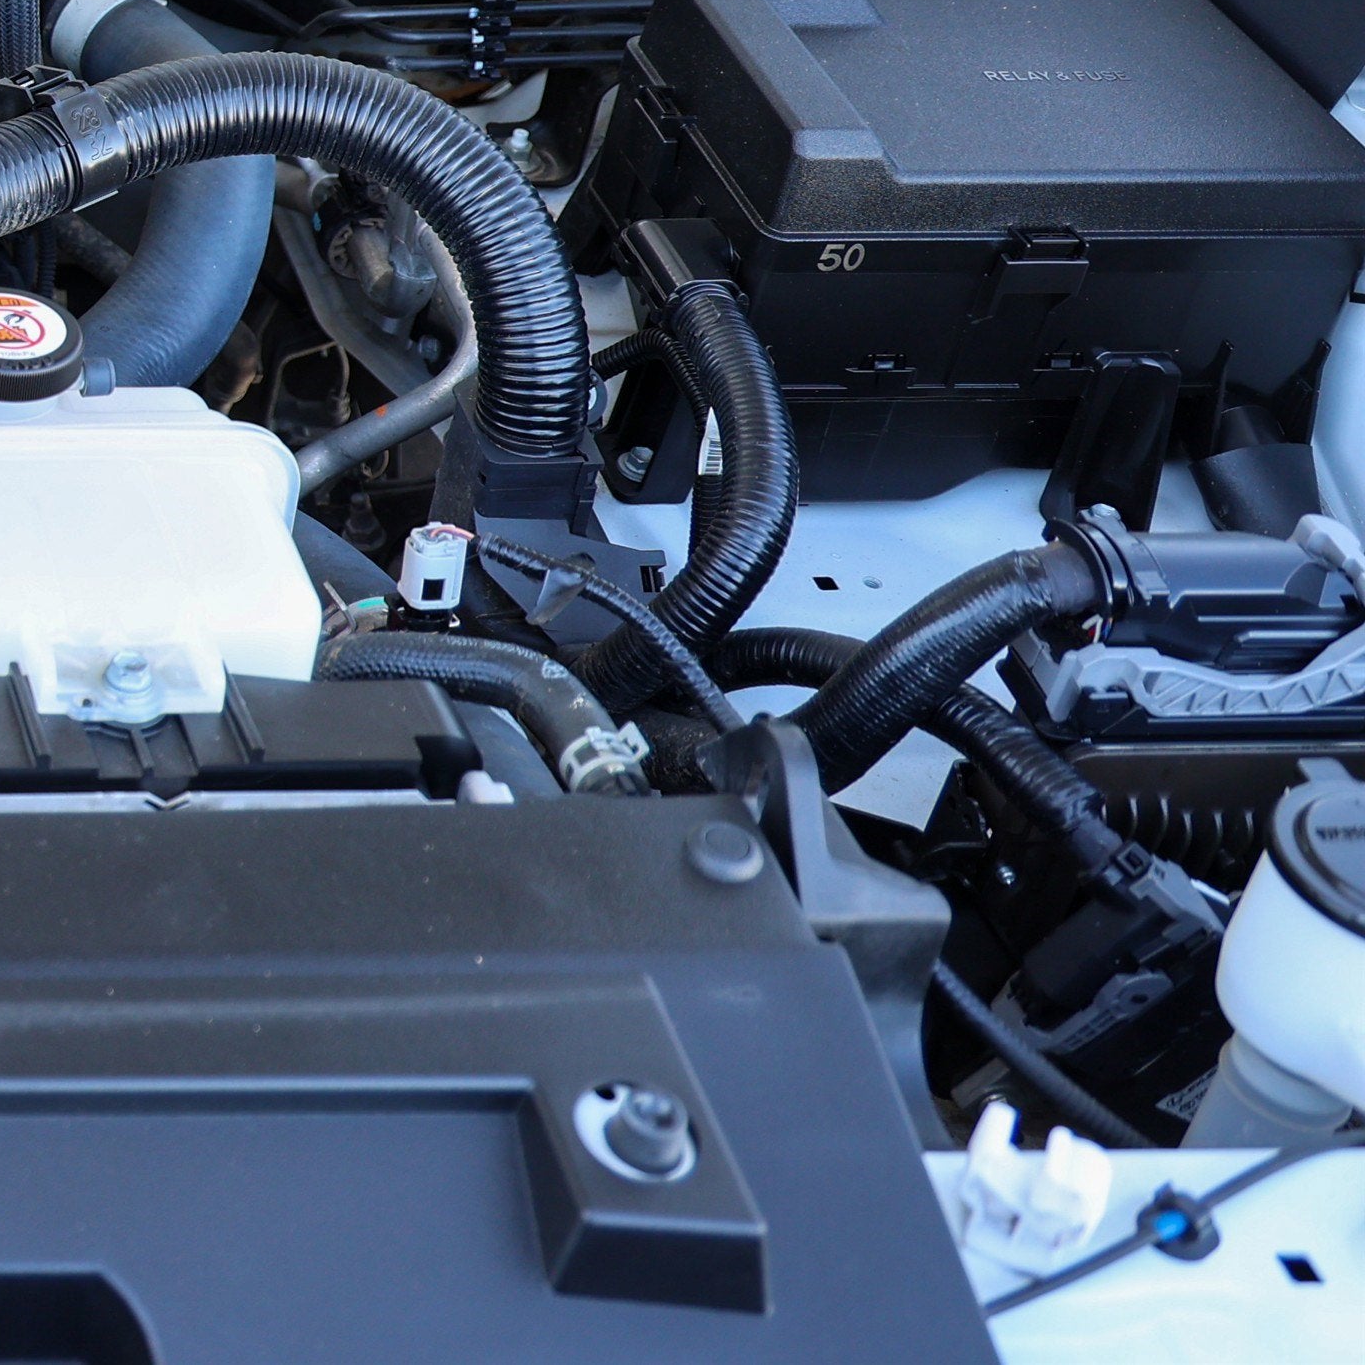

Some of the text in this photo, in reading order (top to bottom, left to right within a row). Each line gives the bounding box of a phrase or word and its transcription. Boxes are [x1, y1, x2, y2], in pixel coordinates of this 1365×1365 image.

[983, 70, 1131, 82] RELAY & FUSE
[71, 103, 102, 135] 28
[83, 128, 115, 161] 32
[816, 243, 866, 272] 50
